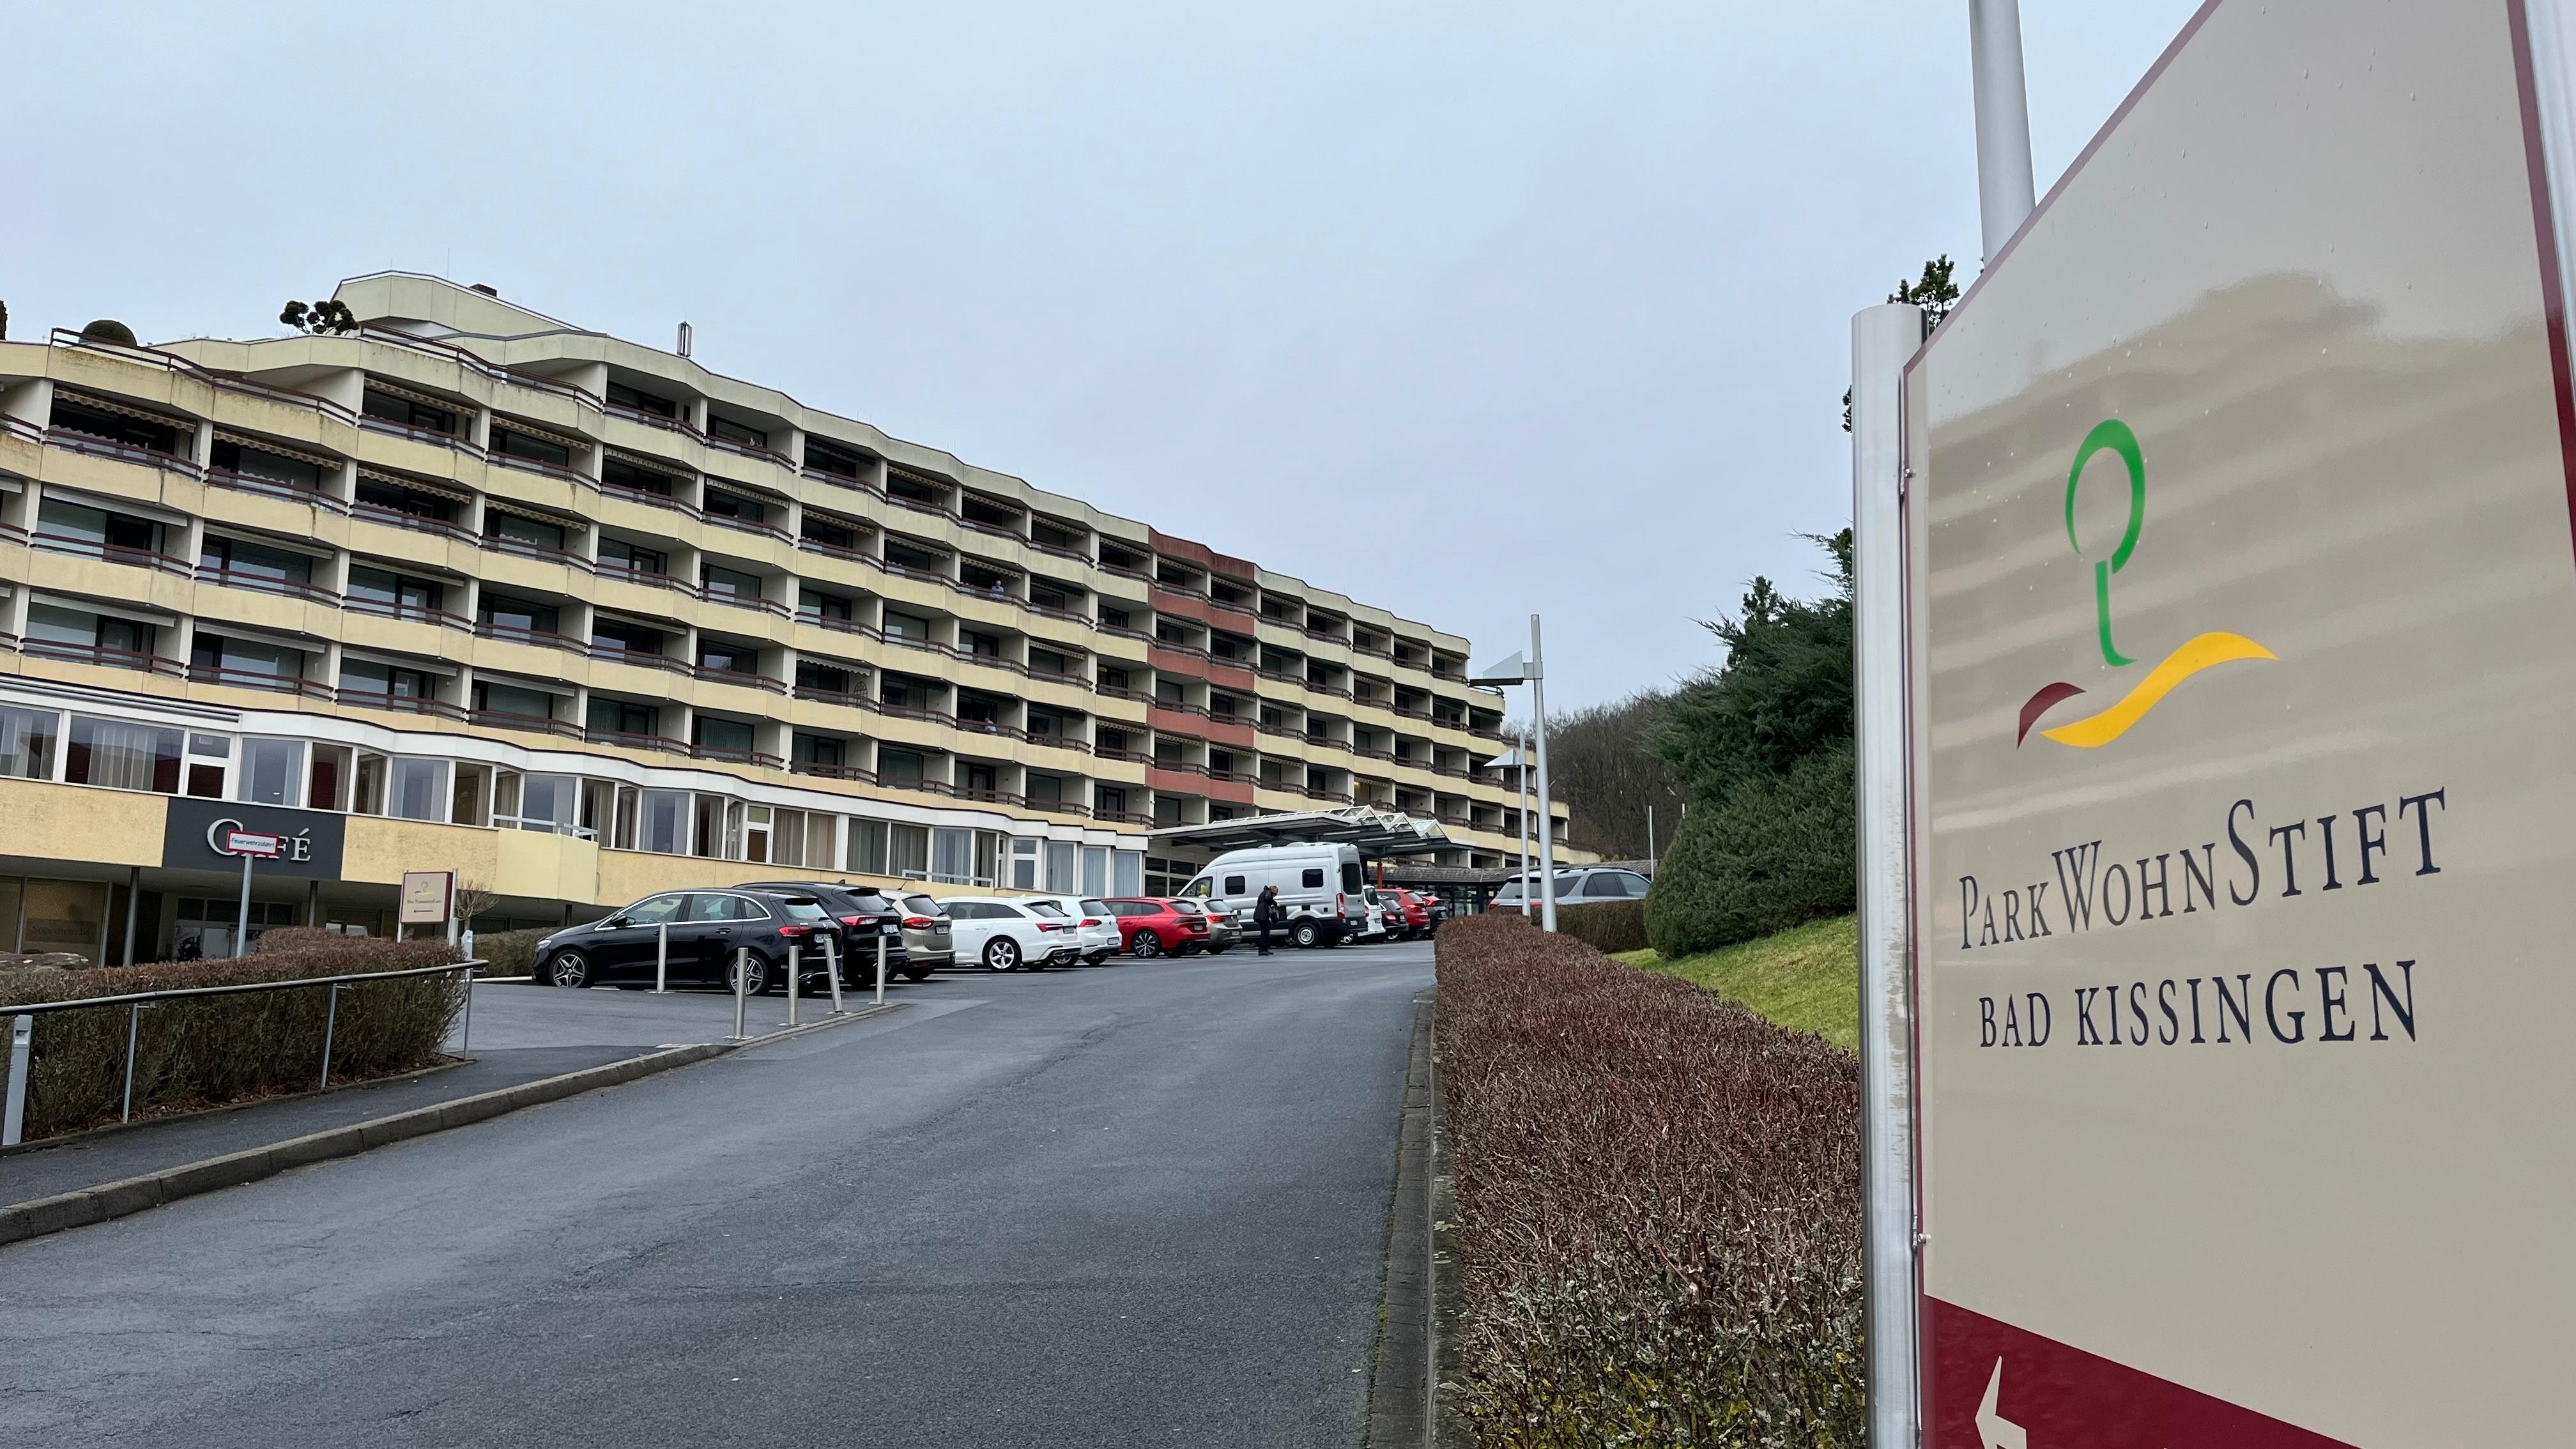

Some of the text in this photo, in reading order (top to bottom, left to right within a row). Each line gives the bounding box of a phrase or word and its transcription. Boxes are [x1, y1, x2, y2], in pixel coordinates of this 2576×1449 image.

[206, 818, 311, 862] CFÉ
[231, 837, 275, 848] Feuerwehrzufahrt
[1979, 959, 2417, 1048] BAD KISSINGEN
